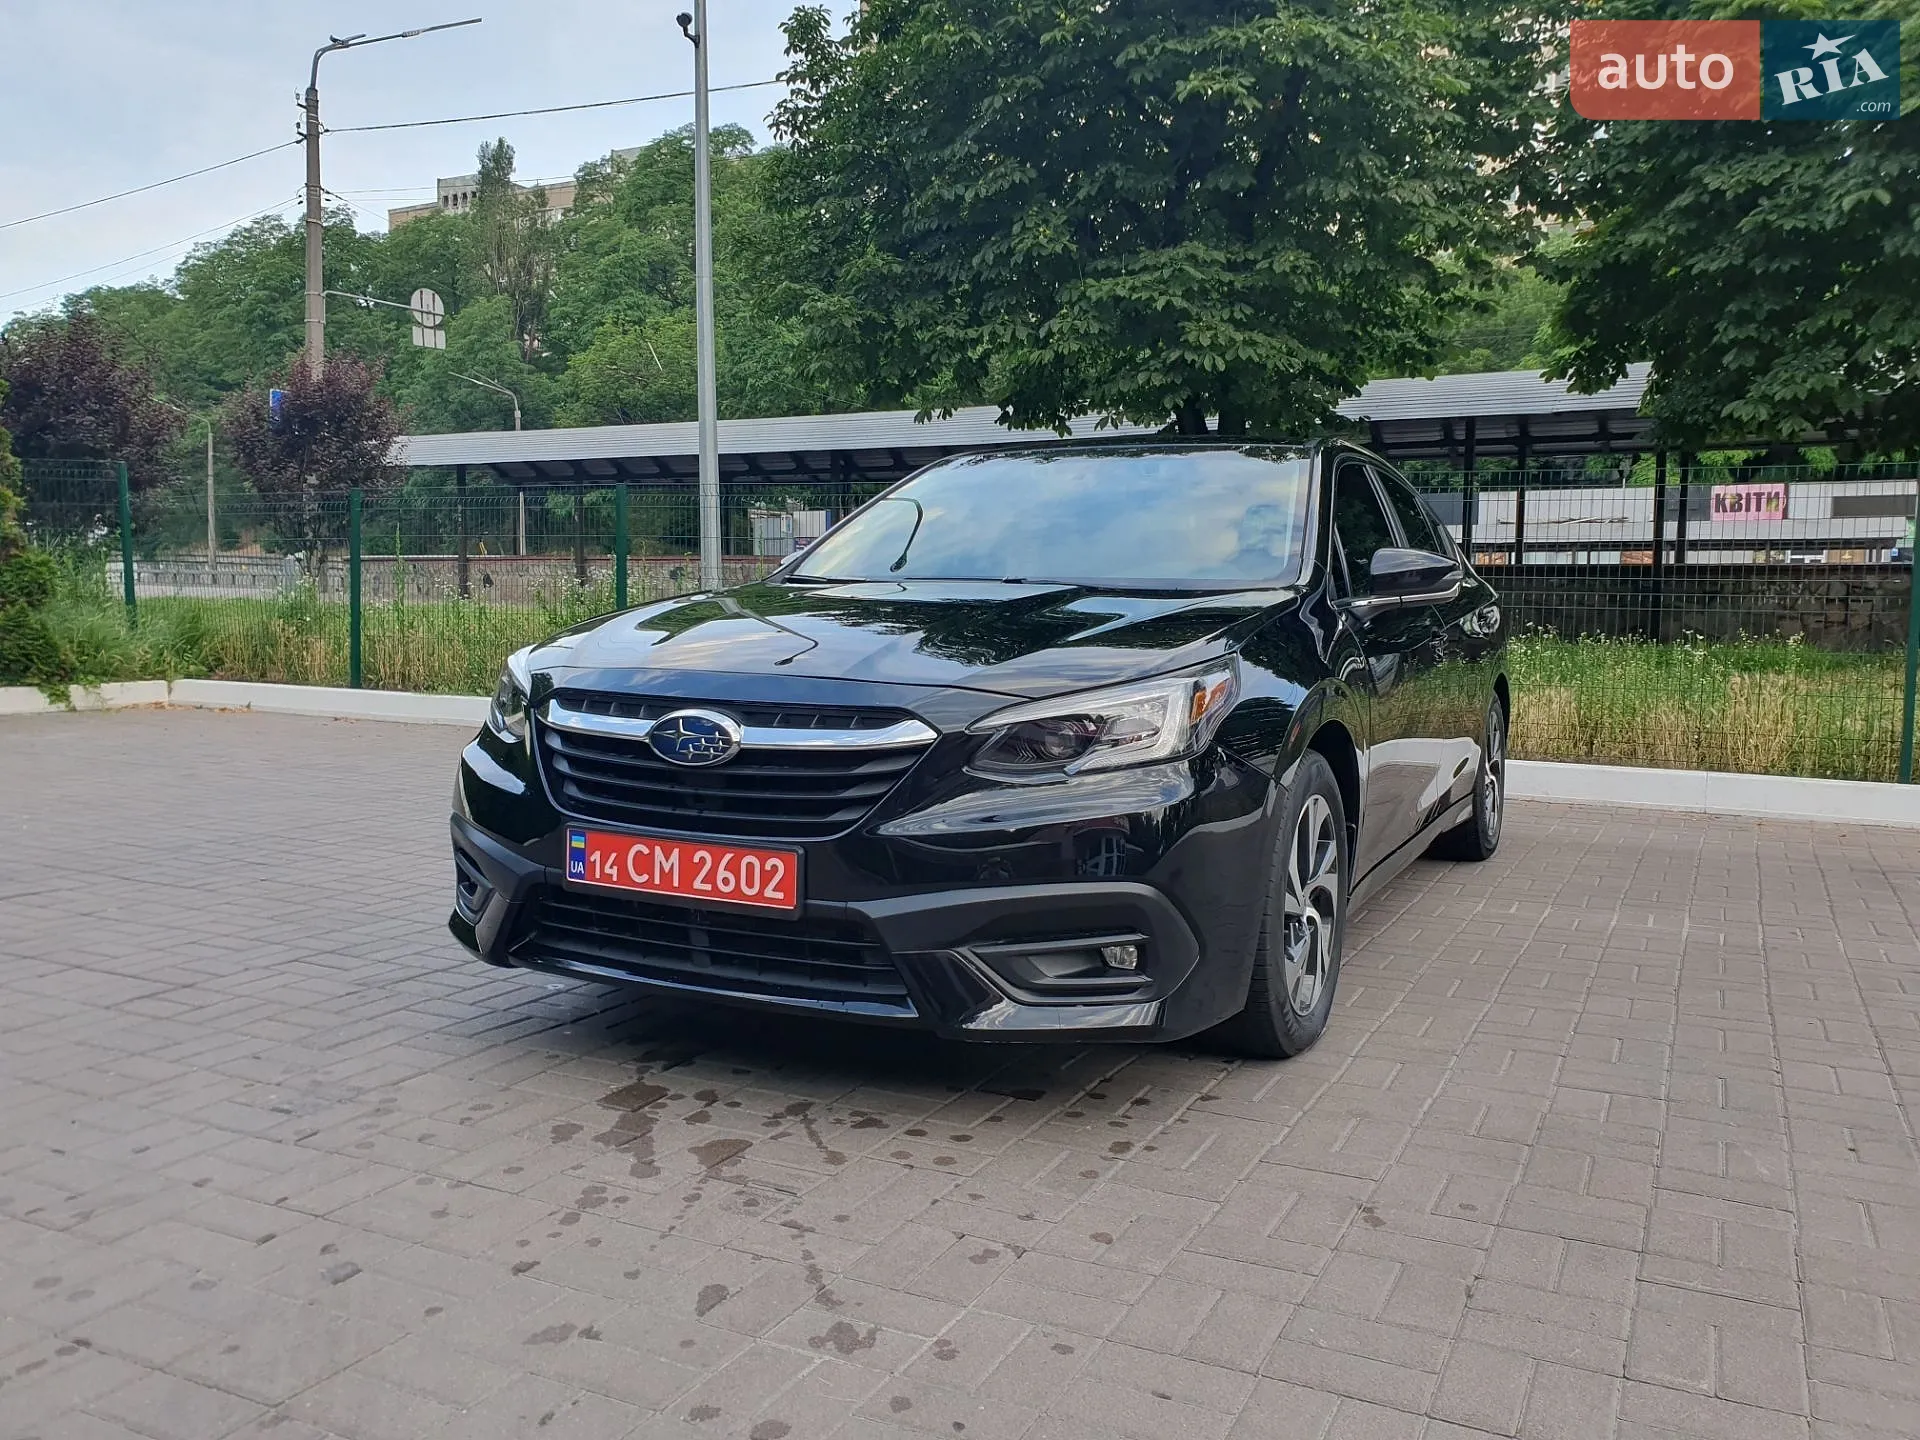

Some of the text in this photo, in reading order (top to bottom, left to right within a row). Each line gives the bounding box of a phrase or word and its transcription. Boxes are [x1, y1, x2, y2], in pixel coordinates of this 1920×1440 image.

[1714, 491, 1780, 513] КВІТИ
[570, 861, 584, 874] UA
[590, 850, 618, 881] 14
[693, 850, 785, 898] 2602
